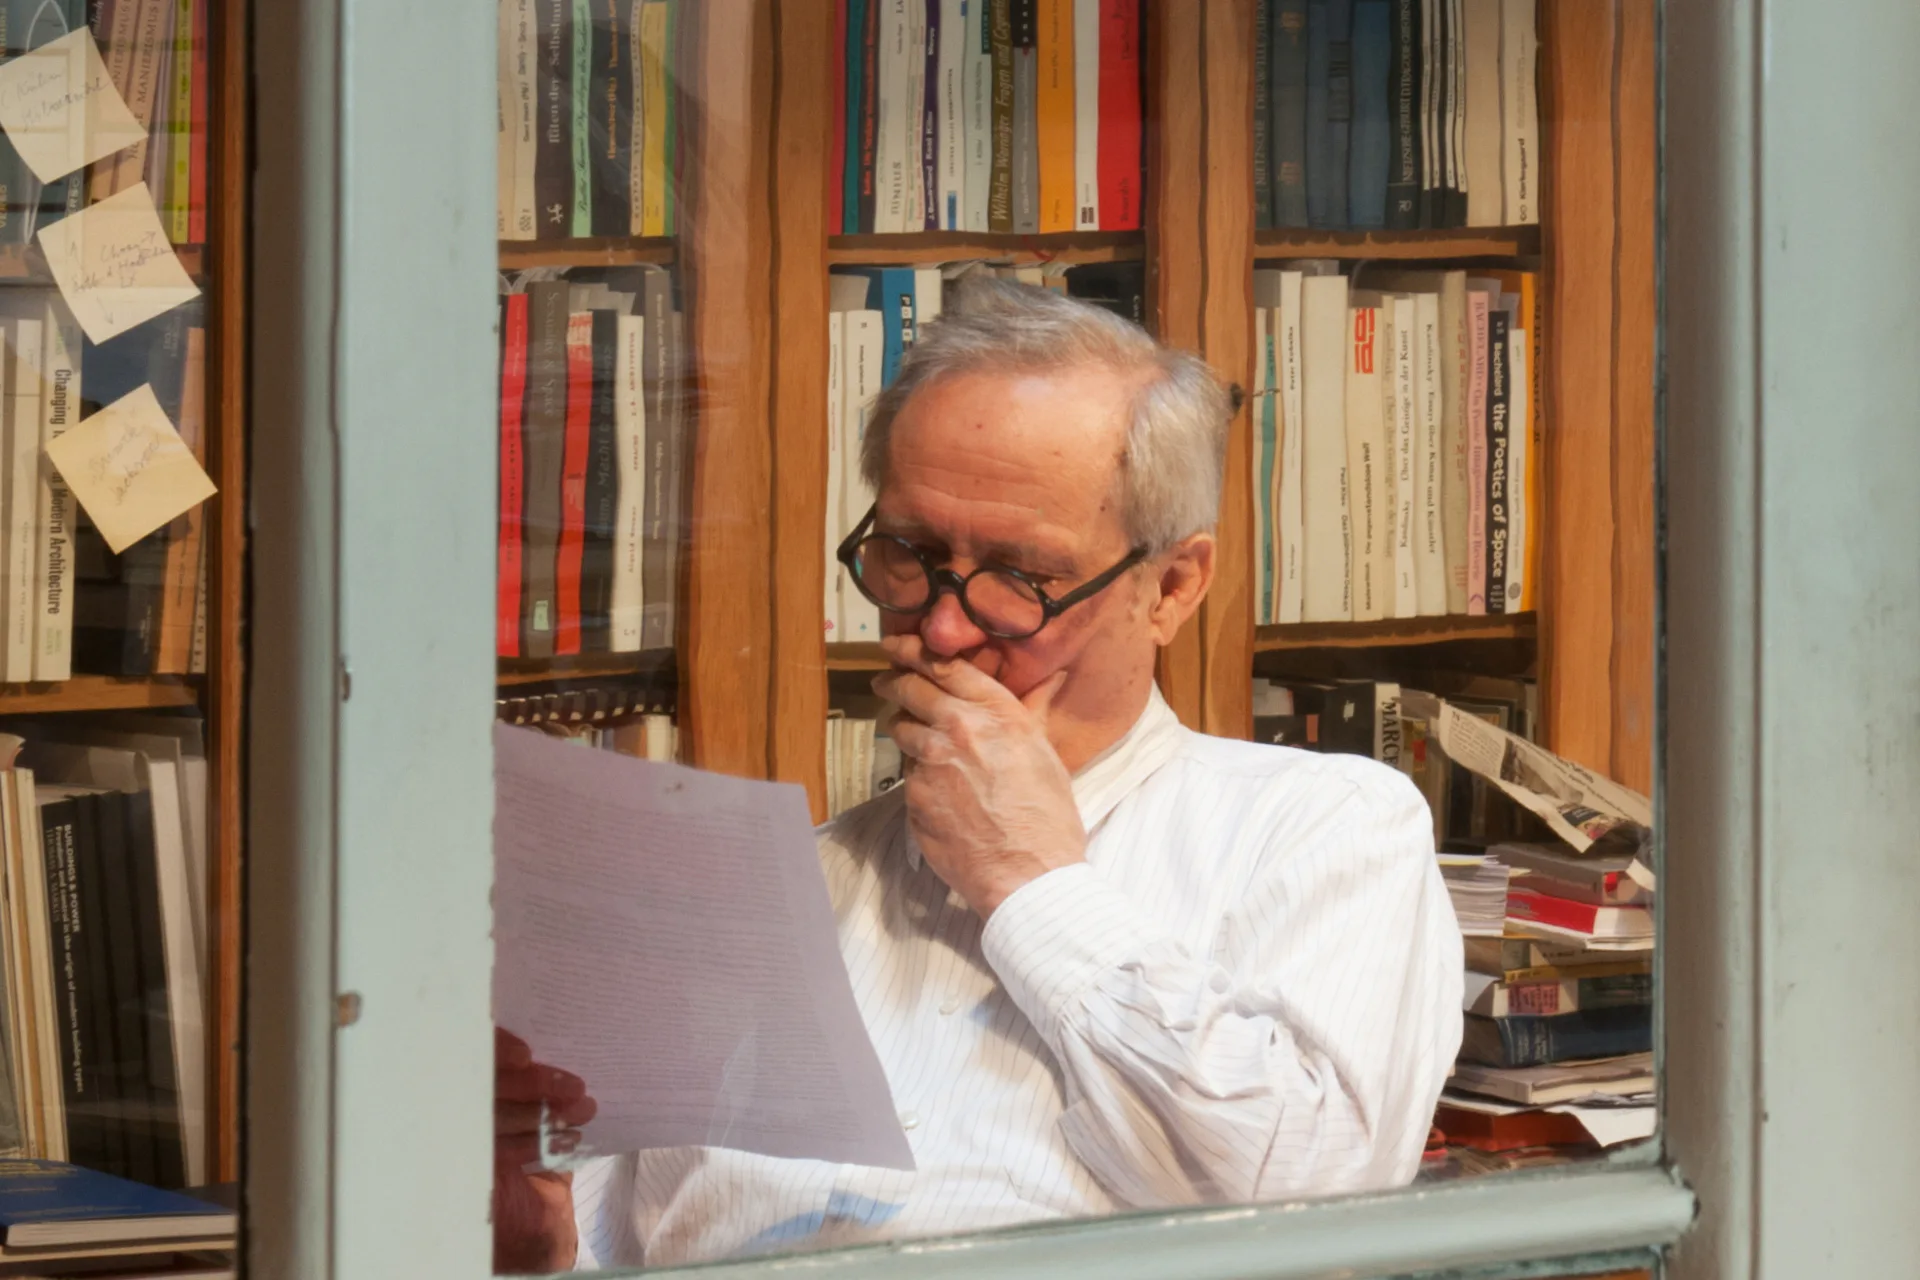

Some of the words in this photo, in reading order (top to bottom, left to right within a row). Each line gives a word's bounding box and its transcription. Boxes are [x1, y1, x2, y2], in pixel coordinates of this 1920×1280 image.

[111, 3, 129, 93] ANIERISMUS
[136, 5, 159, 105] MANIERISMUS
[993, 42, 1010, 66] und
[548, 77, 562, 102] der
[995, 69, 1014, 107] Fragen
[548, 104, 562, 144] Riten
[1254, 119, 1267, 187] NIETZSCHE
[1516, 138, 1528, 200] Kierkegaard
[890, 162, 902, 216] JUNIUS
[992, 172, 1009, 221] Wilhelm
[543, 292, 561, 354] Sexuality
[1474, 302, 1486, 383] BACHELARD
[1399, 329, 1409, 362] Kunst
[1425, 323, 1437, 382] Kandinsky
[1289, 366, 1297, 391] Peter
[1493, 342, 1505, 397] Bachelard
[49, 368, 73, 426] Changing
[539, 378, 557, 418] Space
[1492, 403, 1507, 432] the
[596, 439, 611, 487] Macht
[1340, 466, 1348, 486] Paul
[1428, 451, 1437, 483] Kunst
[1471, 445, 1484, 512] Imagination
[1491, 437, 1507, 499] Poetics
[48, 488, 69, 534] Modern
[1340, 486, 1348, 508] Klee
[1427, 486, 1436, 507] und
[1492, 503, 1507, 523] of
[1341, 514, 1349, 532] Das
[1399, 500, 1411, 548] Kandinsky
[1472, 514, 1483, 538] and
[1364, 540, 1372, 555] Die
[1472, 540, 1484, 583] Reverie
[1490, 528, 1507, 578] Space
[47, 537, 67, 615] Architecture
[1382, 700, 1401, 769] MARCE
[55, 825, 65, 869] Freedom
[64, 823, 77, 883] BUILDINGS
[58, 870, 67, 888] and
[59, 888, 70, 923] control
[70, 893, 82, 933] POWER
[64, 934, 72, 950] the
[64, 952, 75, 980] origin
[68, 991, 78, 1029] modern
[71, 1029, 82, 1067] building
[74, 1067, 85, 1093] types
